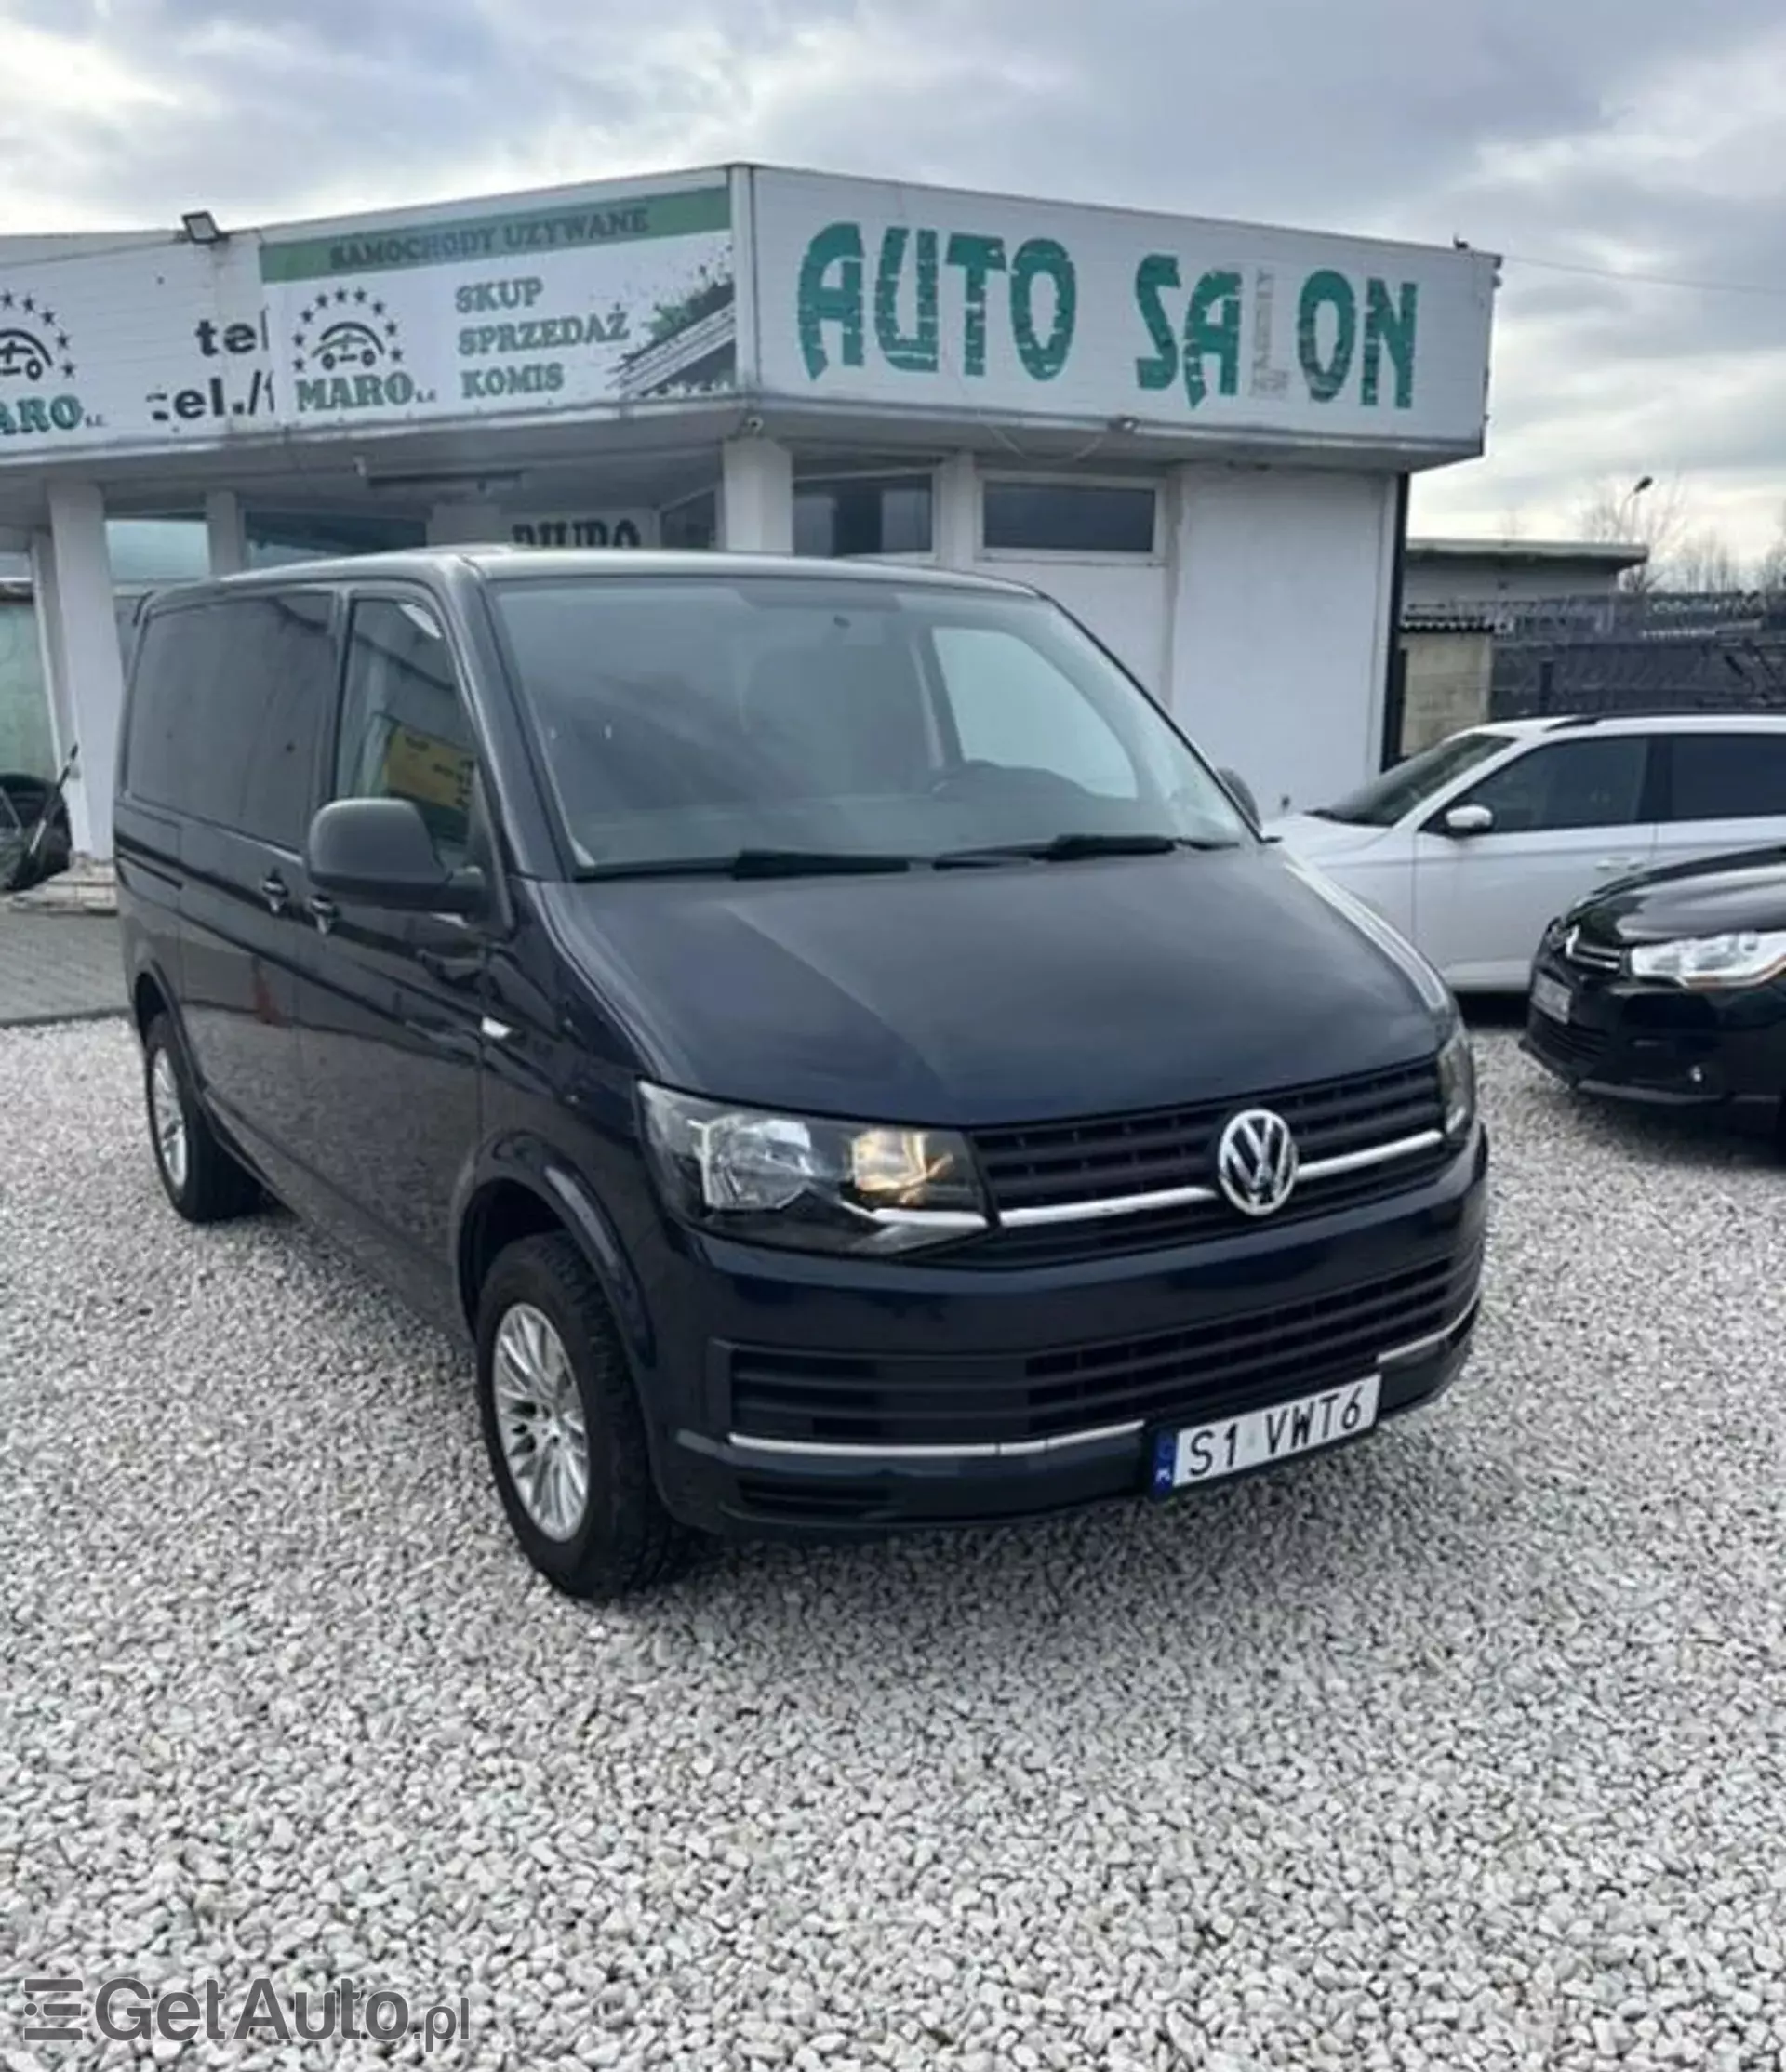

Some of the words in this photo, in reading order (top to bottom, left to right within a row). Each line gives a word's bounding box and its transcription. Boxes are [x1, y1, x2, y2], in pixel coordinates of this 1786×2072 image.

[329, 230, 493, 269] SAMOCHODY
[455, 276, 544, 313] SKUP
[797, 220, 1078, 381] AUTO
[458, 302, 630, 356] SPRZEDAŻ
[295, 371, 415, 413] MARO
[461, 362, 564, 399] KOMIS
[1189, 1422, 1238, 1476] S1
[1266, 1385, 1364, 1454] VWT6
